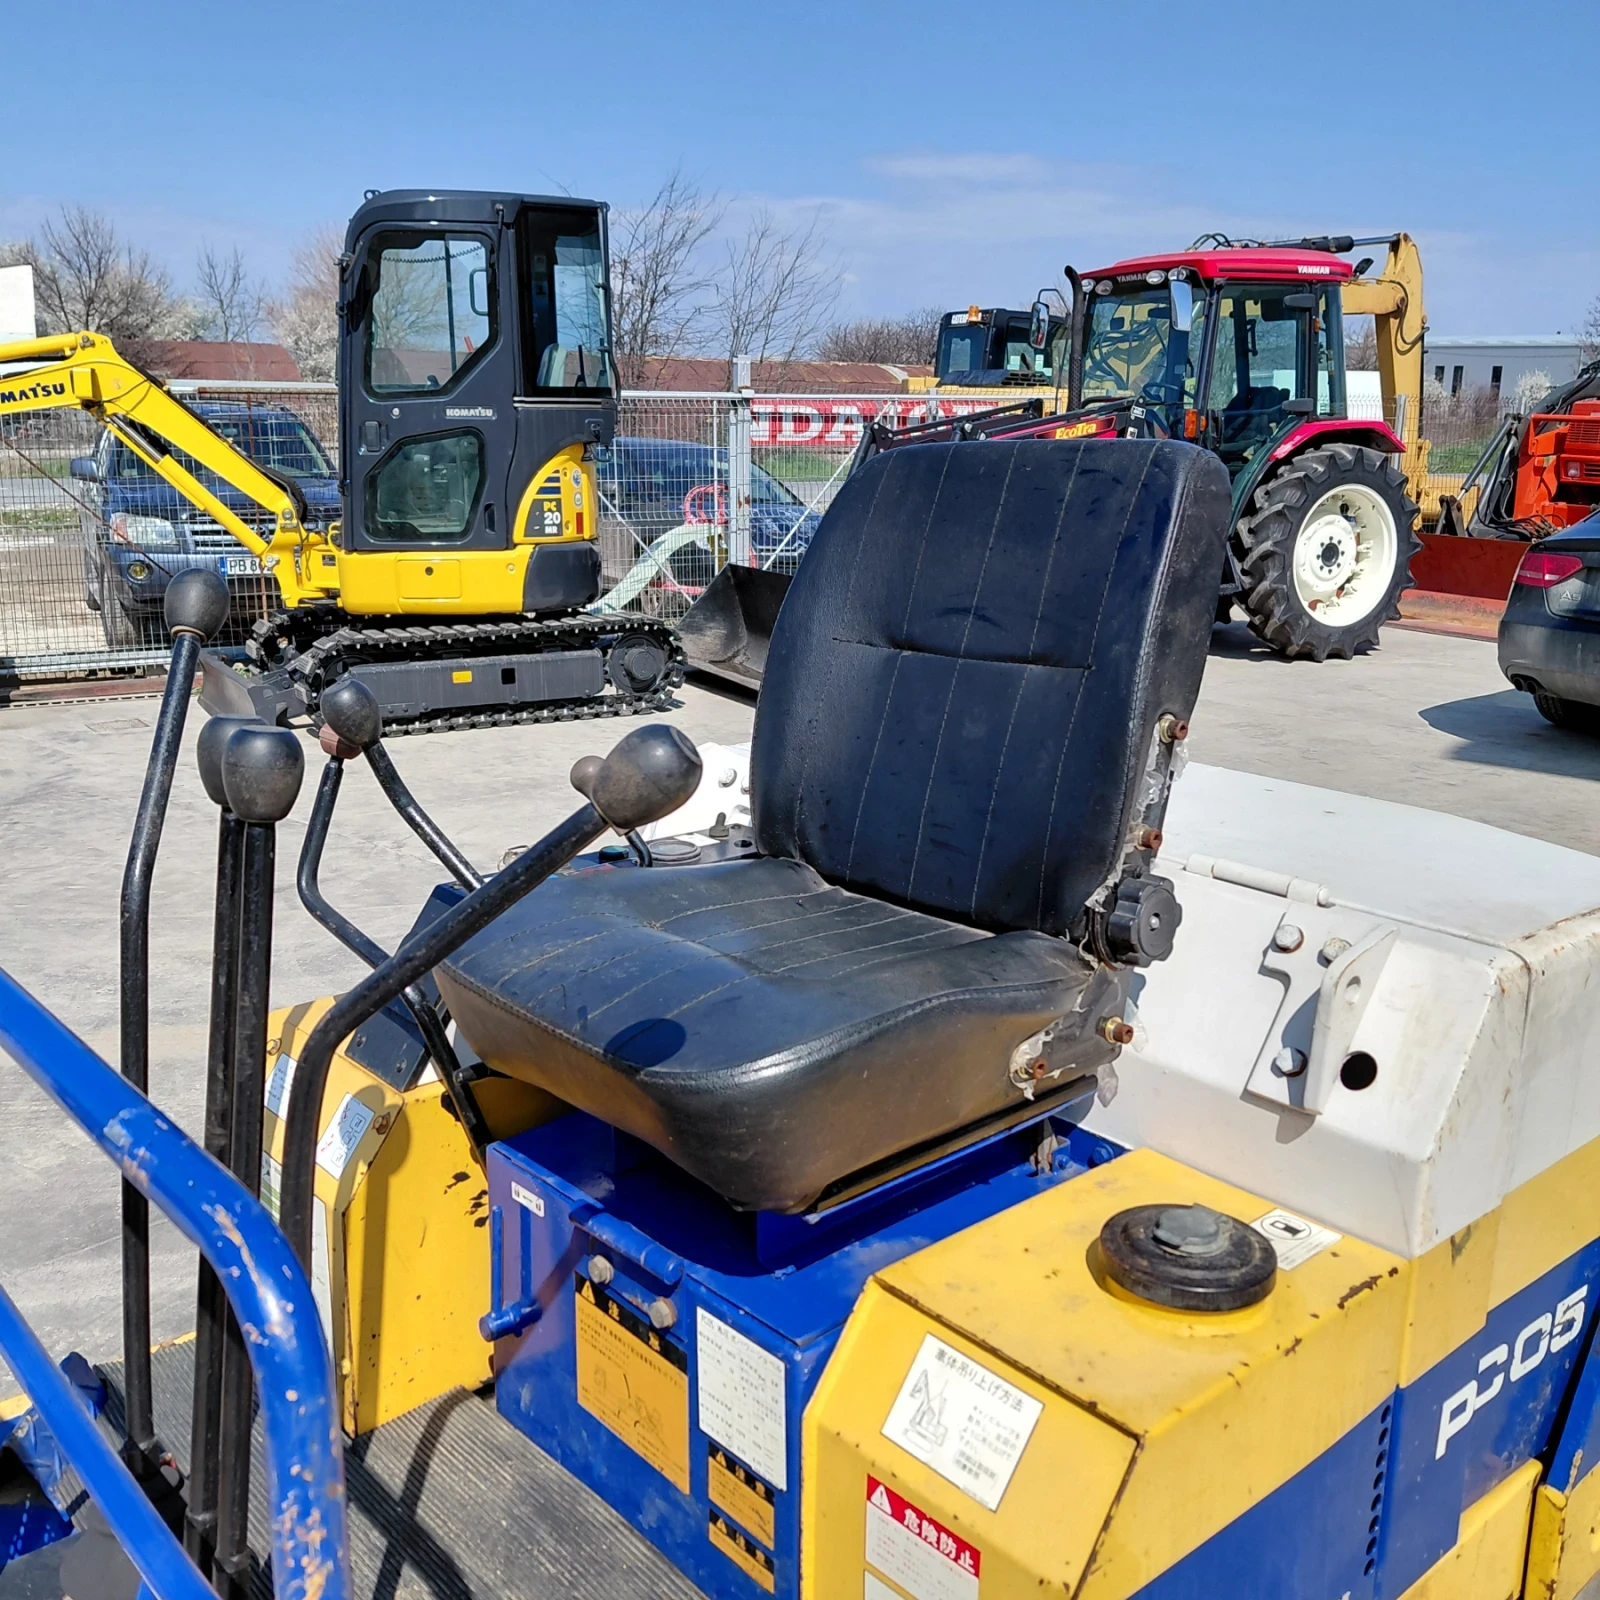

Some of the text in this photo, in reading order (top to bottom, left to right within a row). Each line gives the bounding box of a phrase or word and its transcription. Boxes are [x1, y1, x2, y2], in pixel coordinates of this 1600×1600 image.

[1297, 265, 1330, 275] YANMAR
[445, 406, 494, 417] KOMATSU
[1055, 422, 1097, 439] EcoTra
[543, 501, 557, 512] PC
[543, 511, 562, 525] 20
[544, 526, 558, 534] MR
[229, 558, 248, 573] PB
[1434, 1283, 1589, 1461] PC05
[903, 1508, 976, 1574] 危険防止
